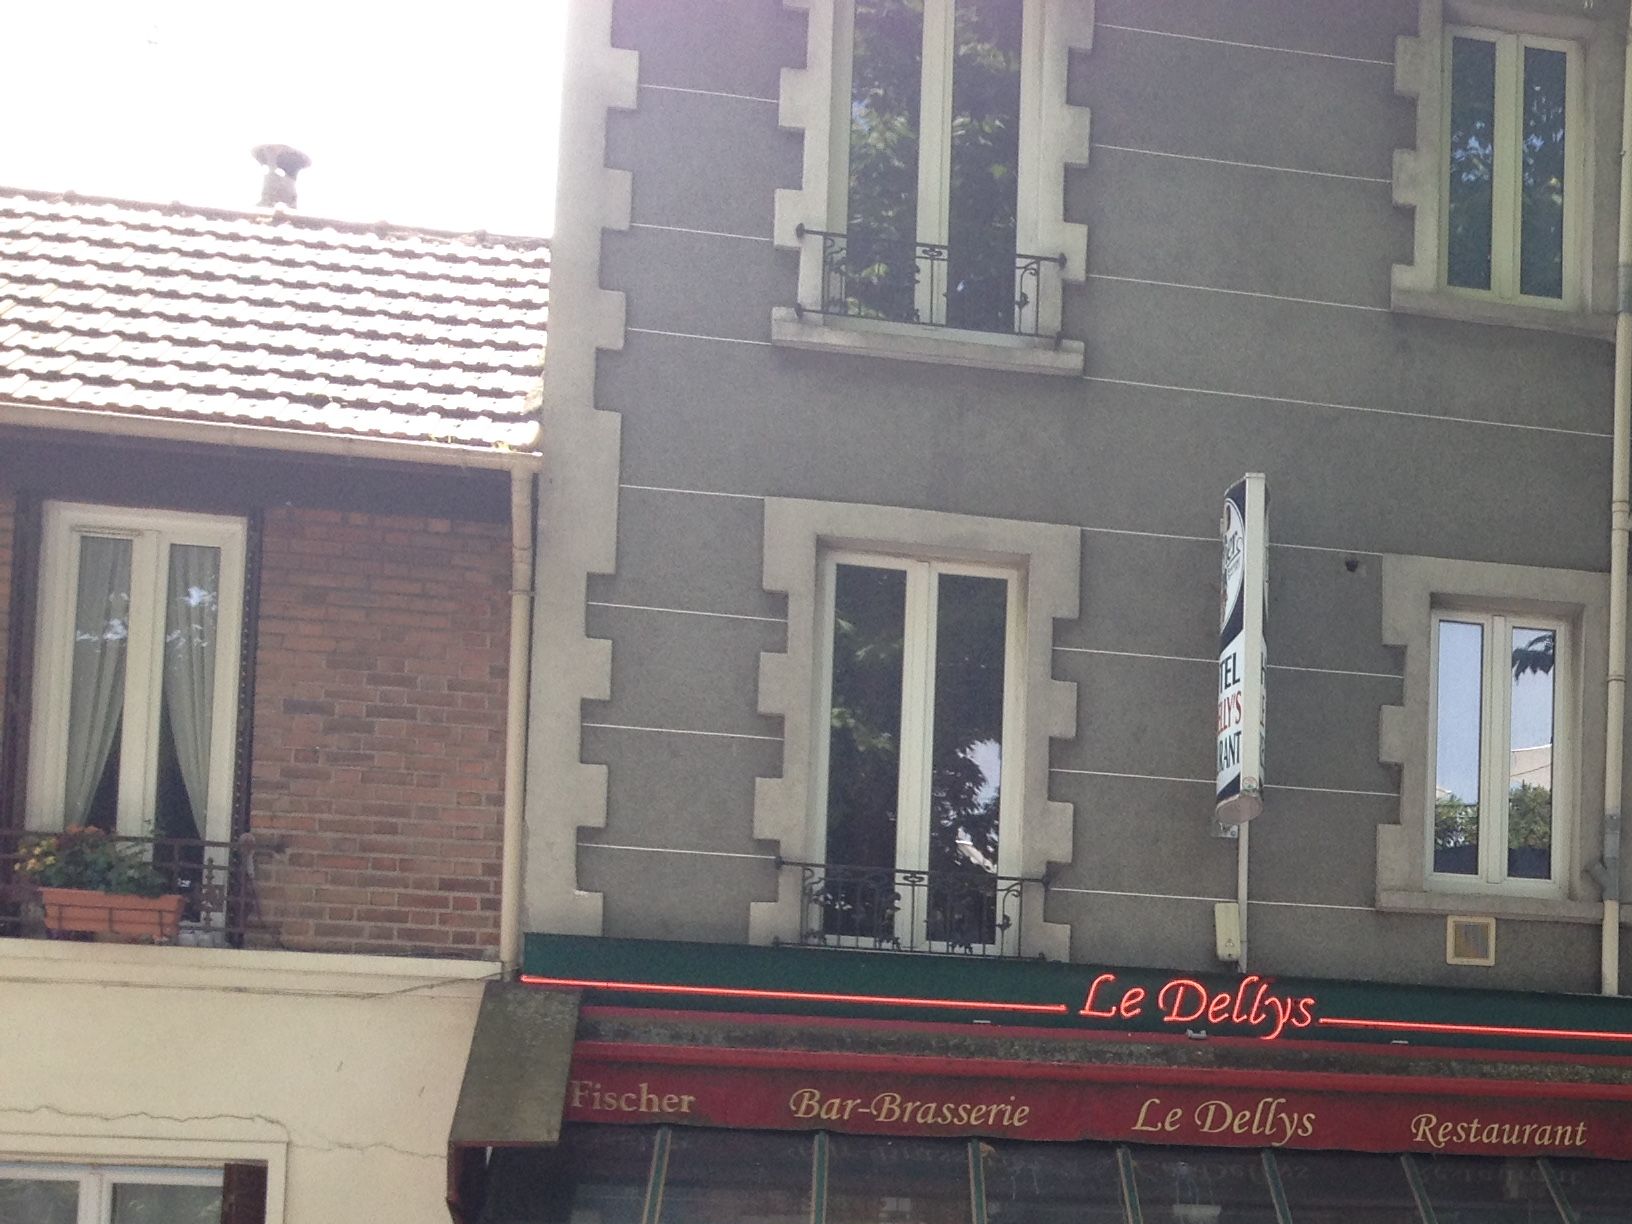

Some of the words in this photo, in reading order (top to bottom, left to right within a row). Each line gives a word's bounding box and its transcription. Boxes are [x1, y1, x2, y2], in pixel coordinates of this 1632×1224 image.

[1079, 973, 1146, 1019] Le
[1157, 974, 1318, 1040] Dellys
[571, 1079, 697, 1114] Fischer
[789, 1087, 1031, 1127] Bar-Brasserie
[1131, 1098, 1184, 1133] Le
[1194, 1097, 1316, 1147] Dellys
[1410, 1112, 1588, 1148] Restaurant
